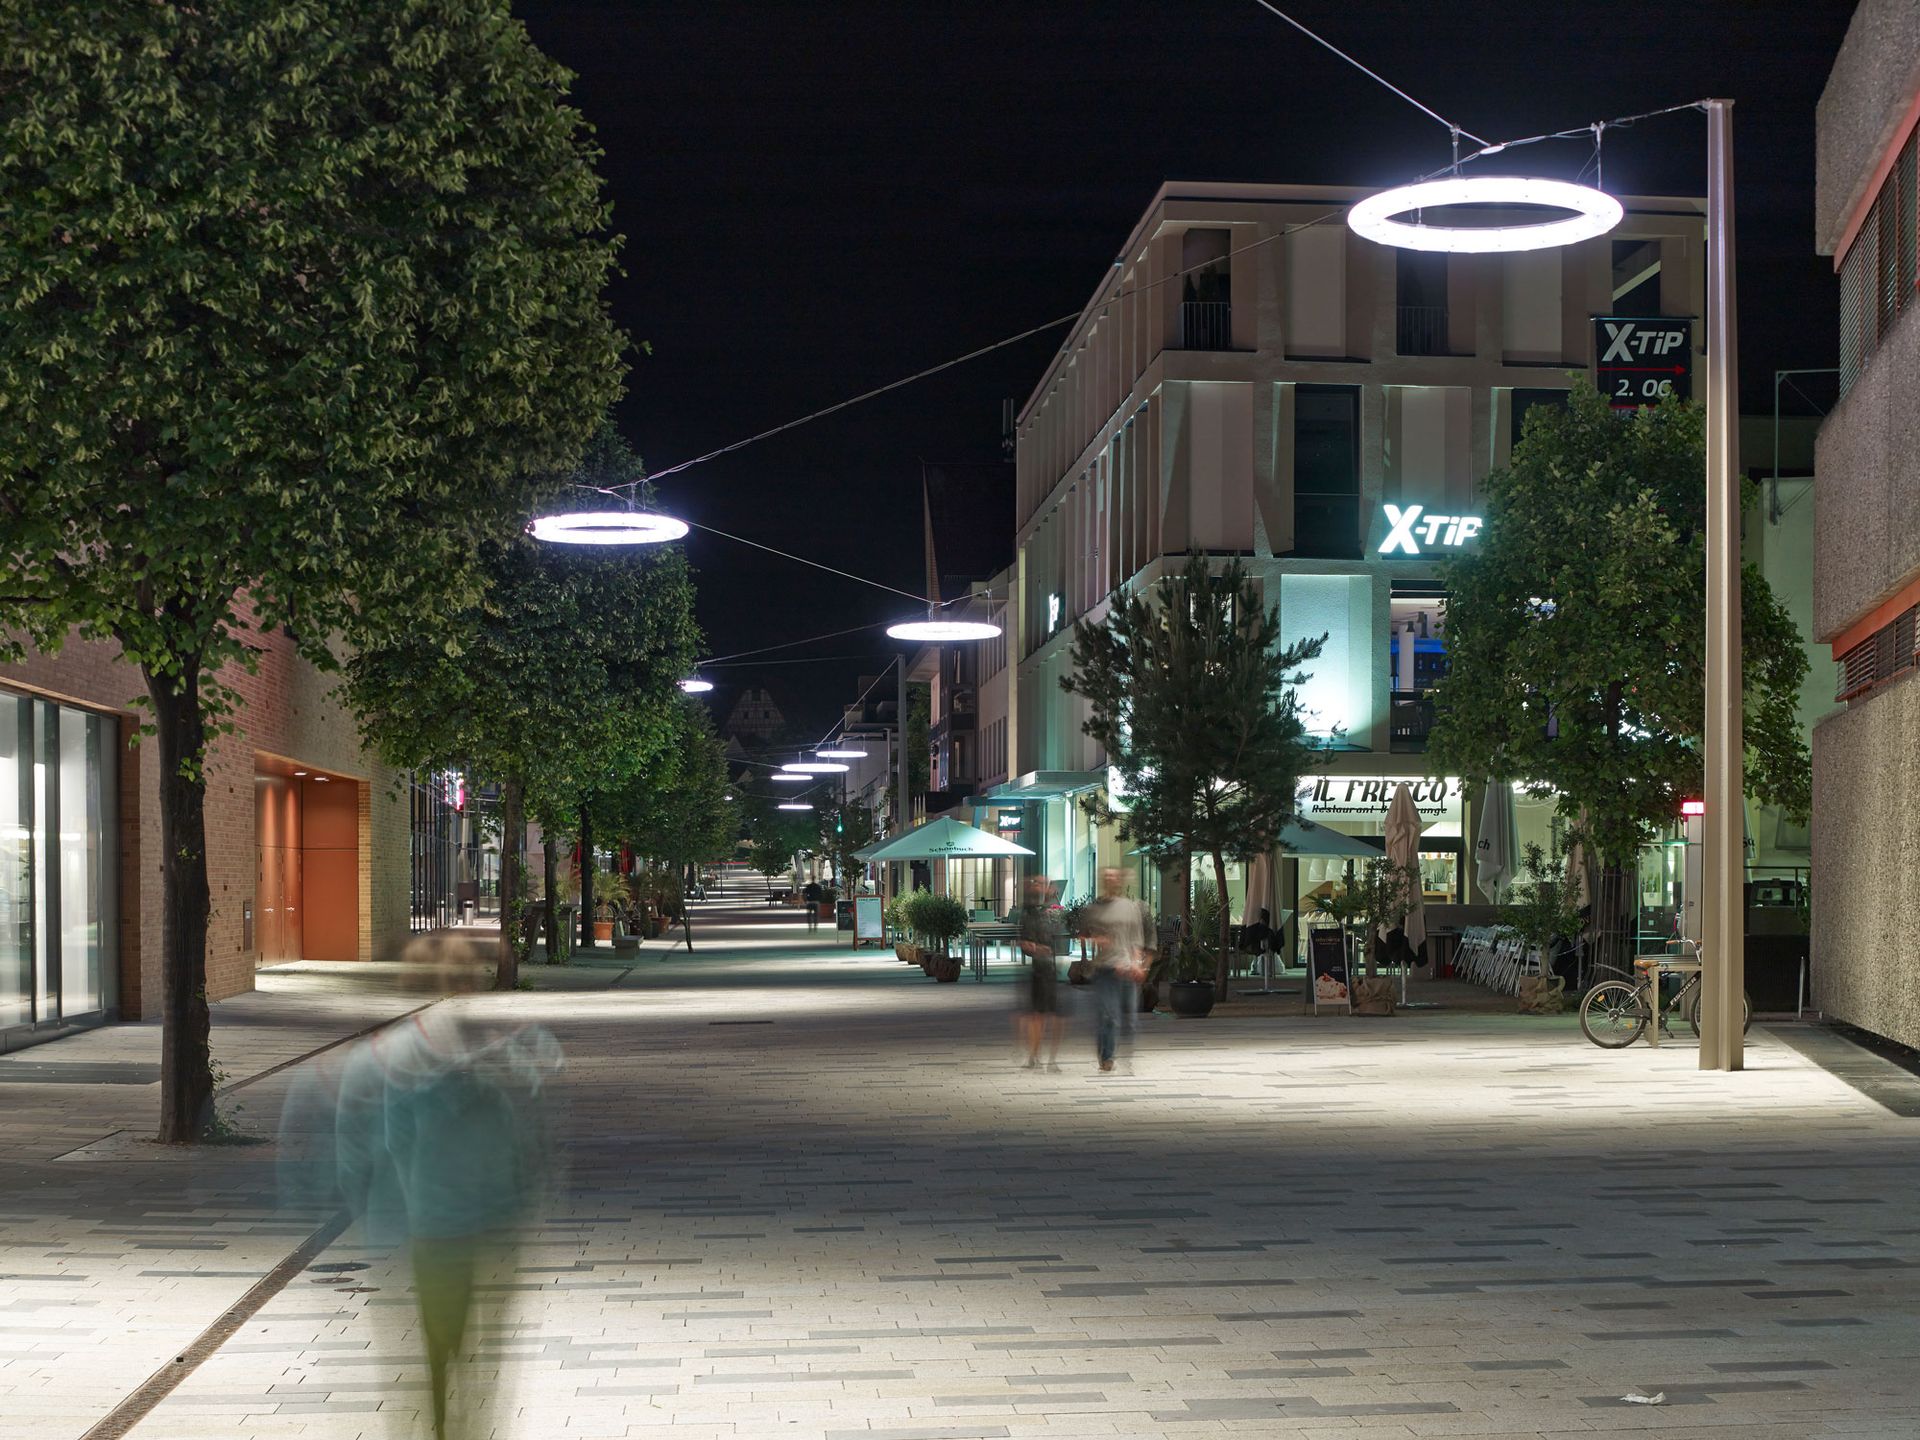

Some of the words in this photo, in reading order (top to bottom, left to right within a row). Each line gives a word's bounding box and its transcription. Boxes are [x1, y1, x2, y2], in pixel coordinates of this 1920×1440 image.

[1615, 379, 1633, 396] 2.
[1312, 779, 1335, 802] IL
[1311, 804, 1373, 814] Restaurant
